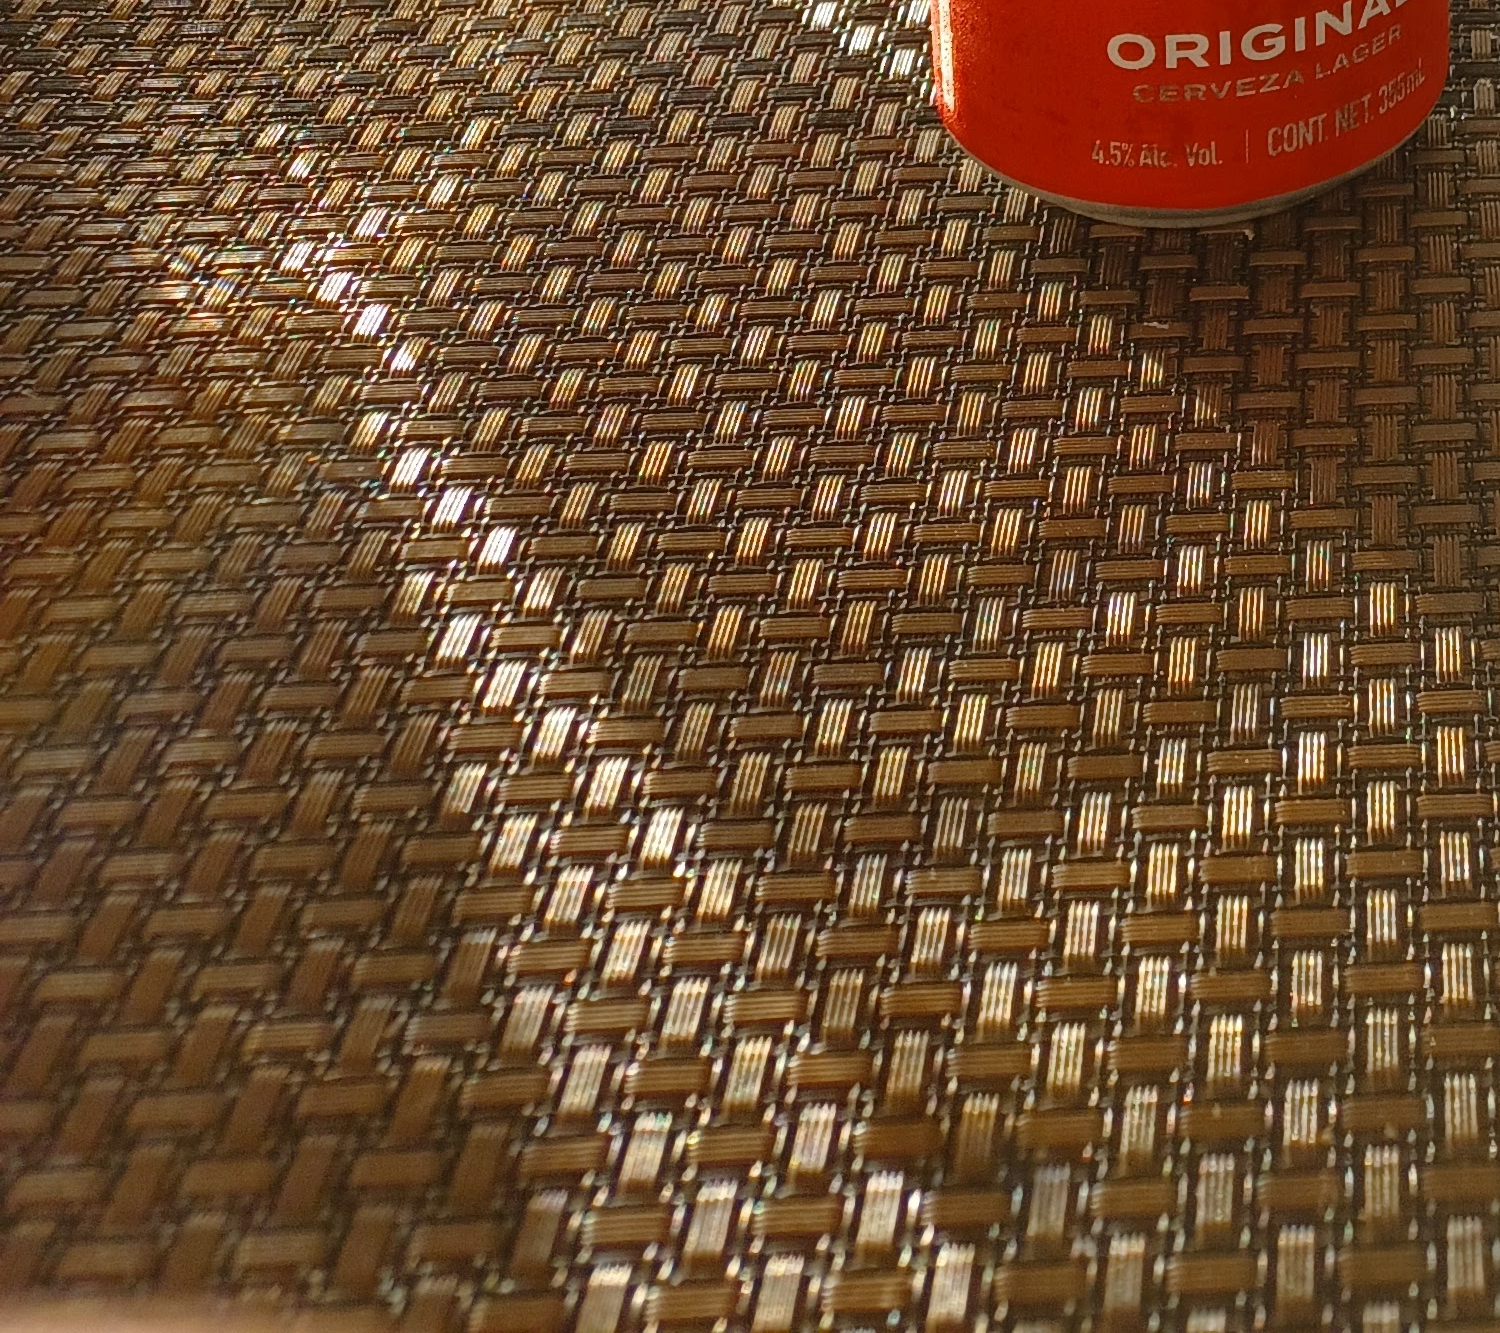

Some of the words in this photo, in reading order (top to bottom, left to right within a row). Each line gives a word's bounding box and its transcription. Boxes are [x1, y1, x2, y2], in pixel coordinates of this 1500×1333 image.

[1132, 68, 1305, 103] CERVEZA
[1315, 23, 1402, 80] LAGER
[1091, 139, 1136, 168] 4.5%
[1185, 140, 1224, 167] Vol.
[1267, 113, 1329, 157] CONT.
